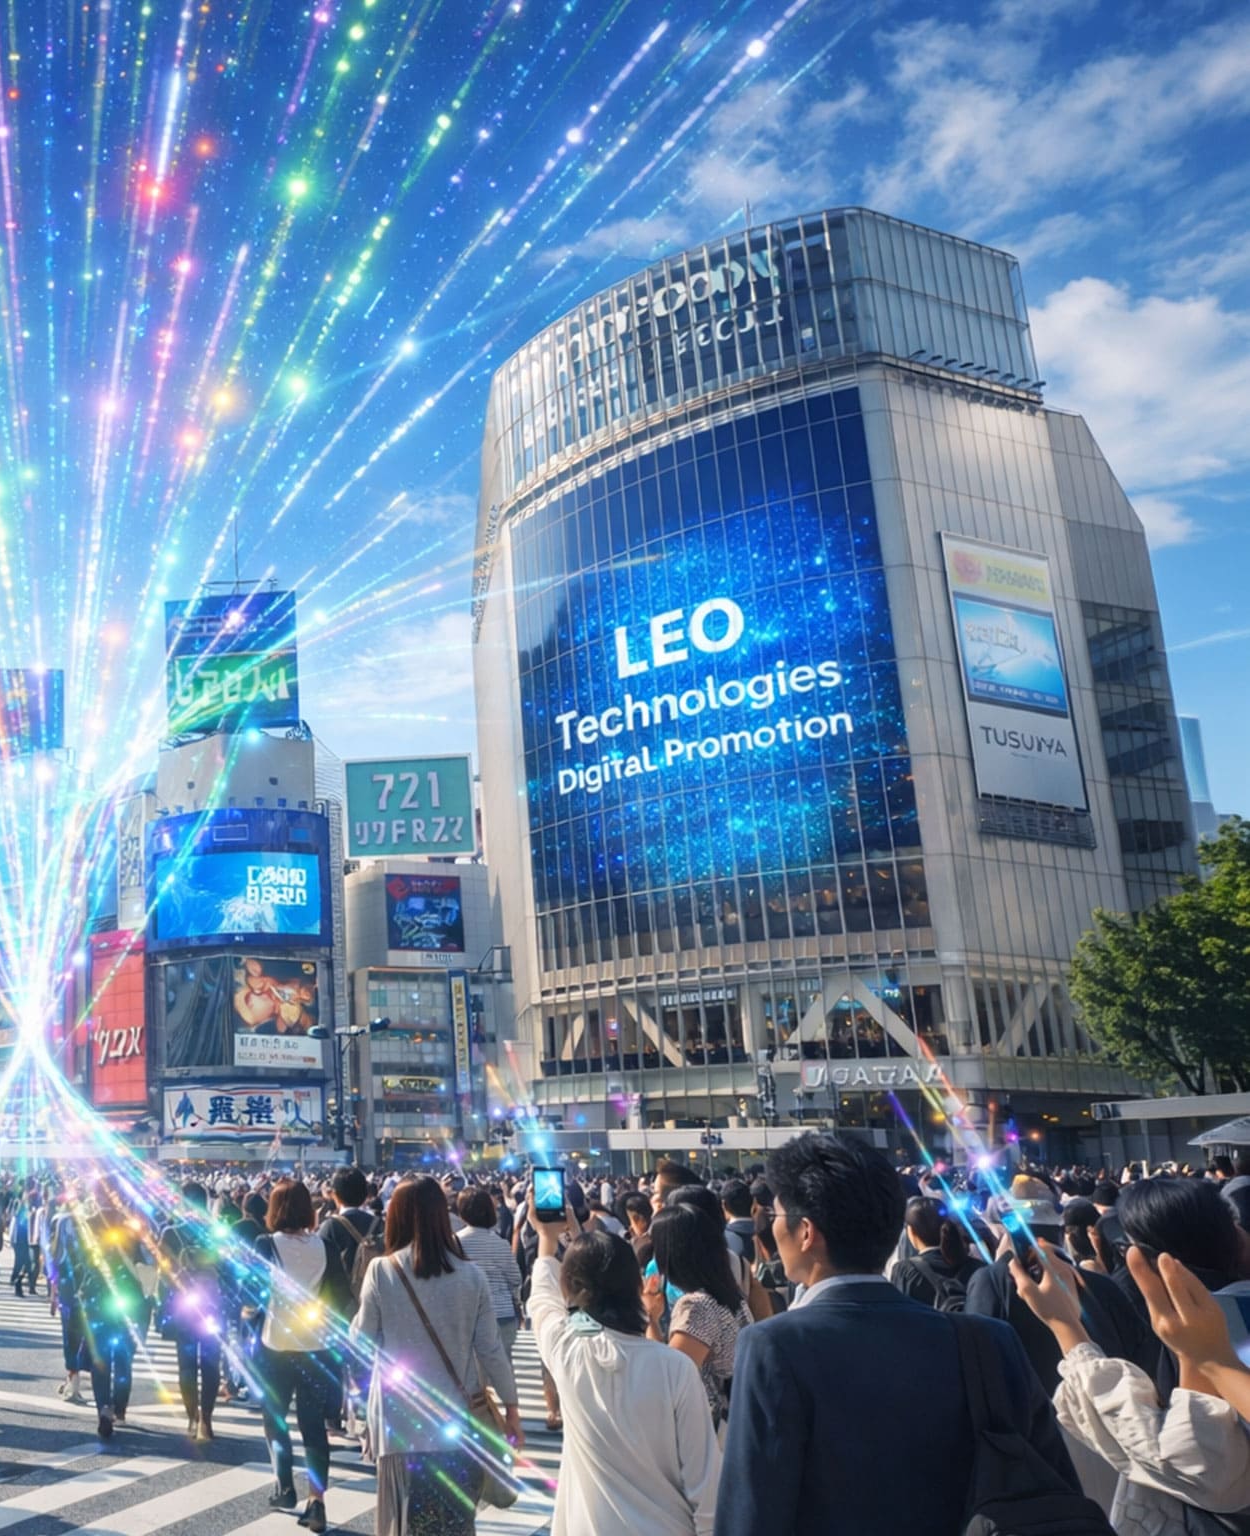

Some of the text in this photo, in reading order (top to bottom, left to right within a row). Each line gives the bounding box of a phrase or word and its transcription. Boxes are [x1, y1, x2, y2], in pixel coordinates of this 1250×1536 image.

[614, 597, 745, 680] LEO
[555, 659, 843, 752] Technologies
[371, 771, 441, 811] 721
[557, 711, 854, 796] Digital Promotion
